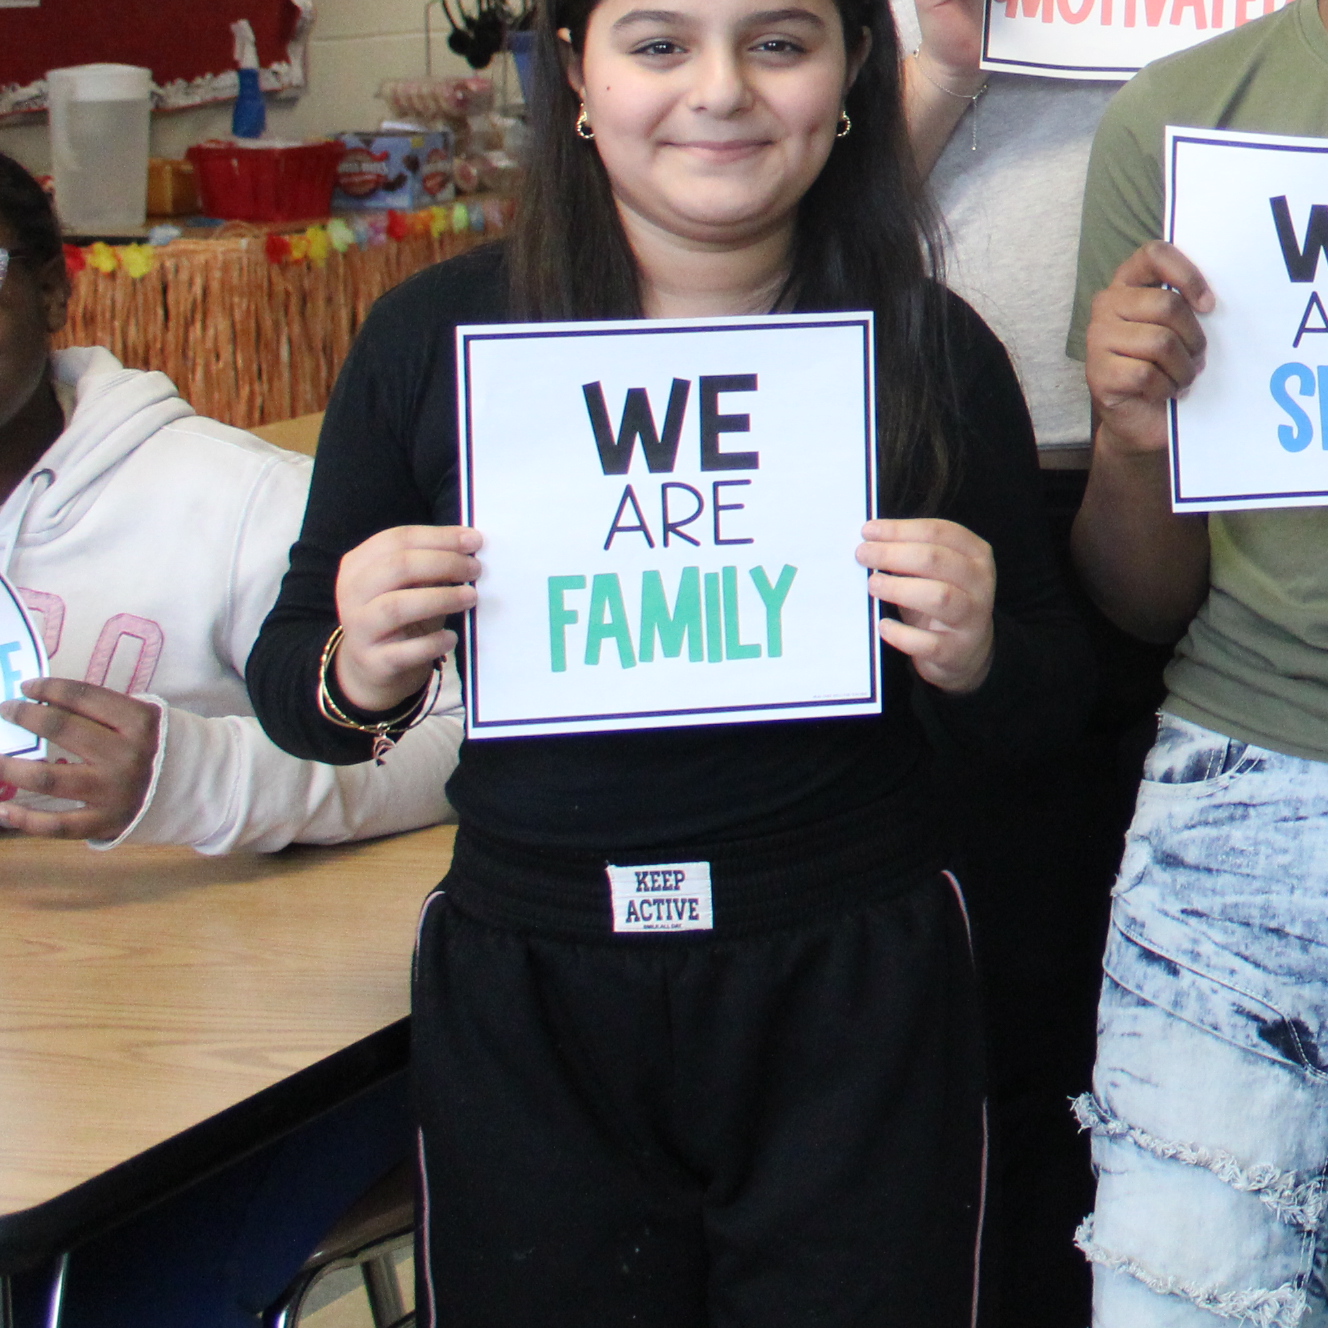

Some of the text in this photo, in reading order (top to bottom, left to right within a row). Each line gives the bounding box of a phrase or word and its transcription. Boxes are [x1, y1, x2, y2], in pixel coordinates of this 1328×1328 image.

[582, 373, 759, 475] WE
[603, 479, 754, 550] ARE
[548, 564, 798, 672] FAMILY
[626, 898, 699, 923] ACTIVE
[635, 870, 685, 892] KEEP
